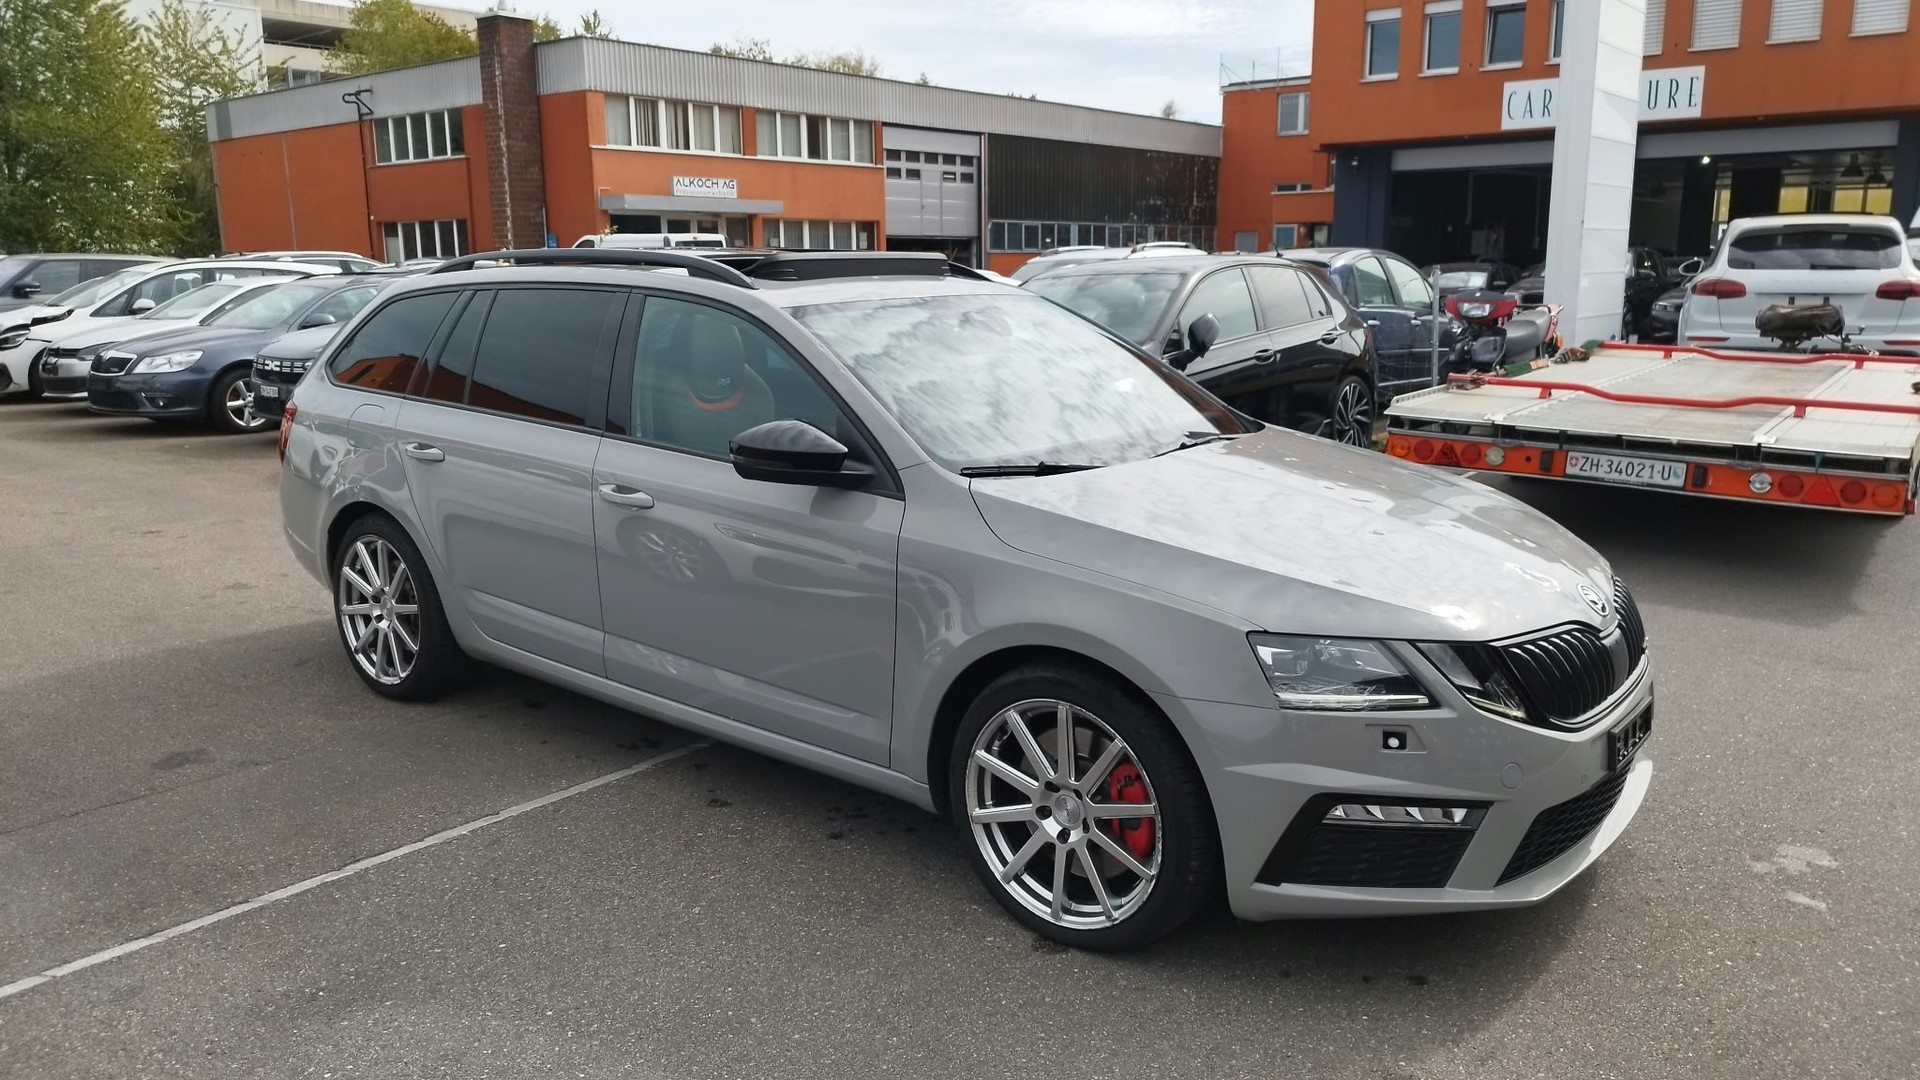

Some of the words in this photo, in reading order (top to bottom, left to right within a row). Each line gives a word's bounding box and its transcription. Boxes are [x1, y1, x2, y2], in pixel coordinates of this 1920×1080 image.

[1507, 89, 1552, 120] CAR
[675, 178, 718, 188] ALKOCH
[722, 179, 735, 189] AG
